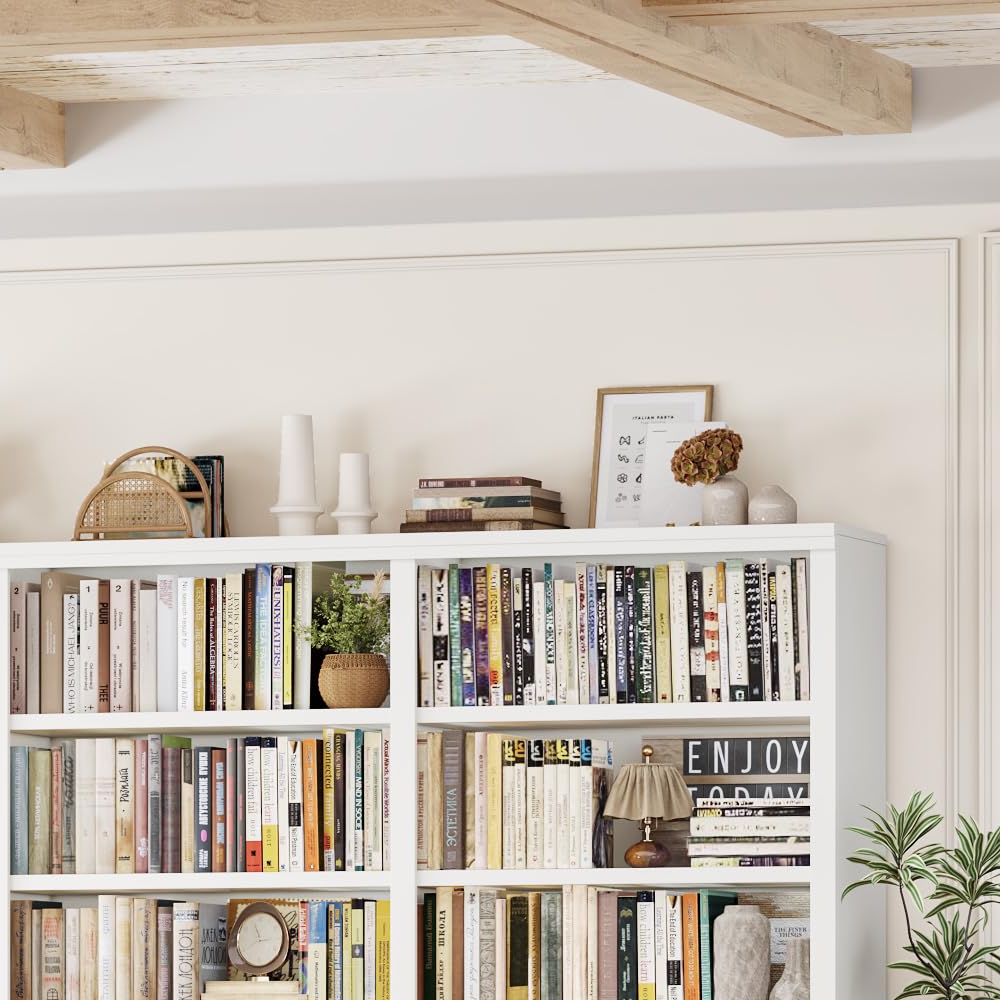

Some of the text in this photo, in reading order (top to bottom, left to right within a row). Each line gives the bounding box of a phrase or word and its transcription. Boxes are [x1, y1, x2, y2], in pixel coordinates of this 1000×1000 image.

[273, 591, 281, 666] UNIX-HATERS
[68, 636, 76, 676] MICHAEL
[99, 602, 108, 702] PUUR THEE
[68, 679, 76, 687] IS
[68, 690, 76, 713] WHO
[263, 749, 274, 764] how
[688, 740, 808, 774] ENJOY
[199, 778, 208, 825] АВГУСТОВСКИЕ
[247, 749, 258, 814] how children fail
[263, 765, 275, 800] children
[263, 803, 274, 823] learn
[447, 788, 457, 847] ЭСТЕТИКА
[177, 928, 194, 980] ЛОНДОН
